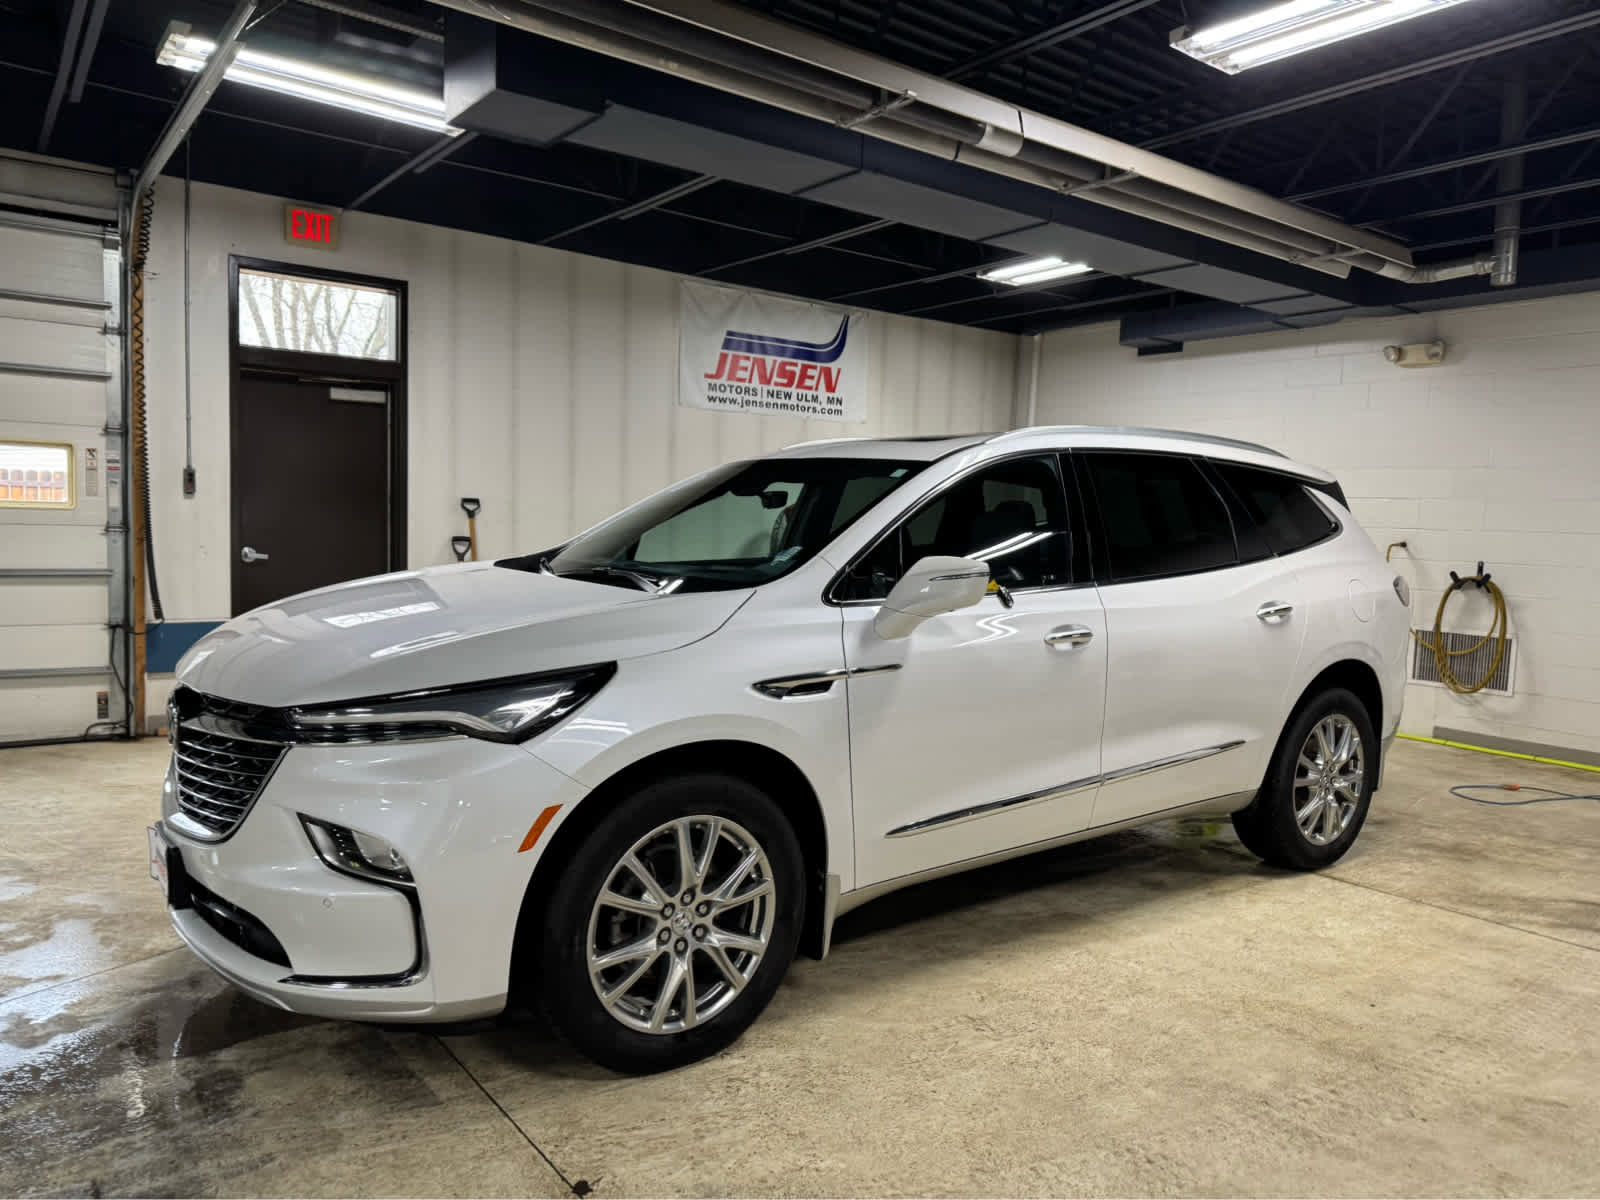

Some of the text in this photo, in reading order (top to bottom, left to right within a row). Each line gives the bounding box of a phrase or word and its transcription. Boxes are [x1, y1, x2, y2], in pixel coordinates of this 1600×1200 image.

[292, 209, 334, 244] EXIT
[704, 352, 842, 394] JENSEN
[707, 382, 843, 407] MOTORS NEW ULM, MN
[707, 395, 843, 416] www.jensenmotors.com
